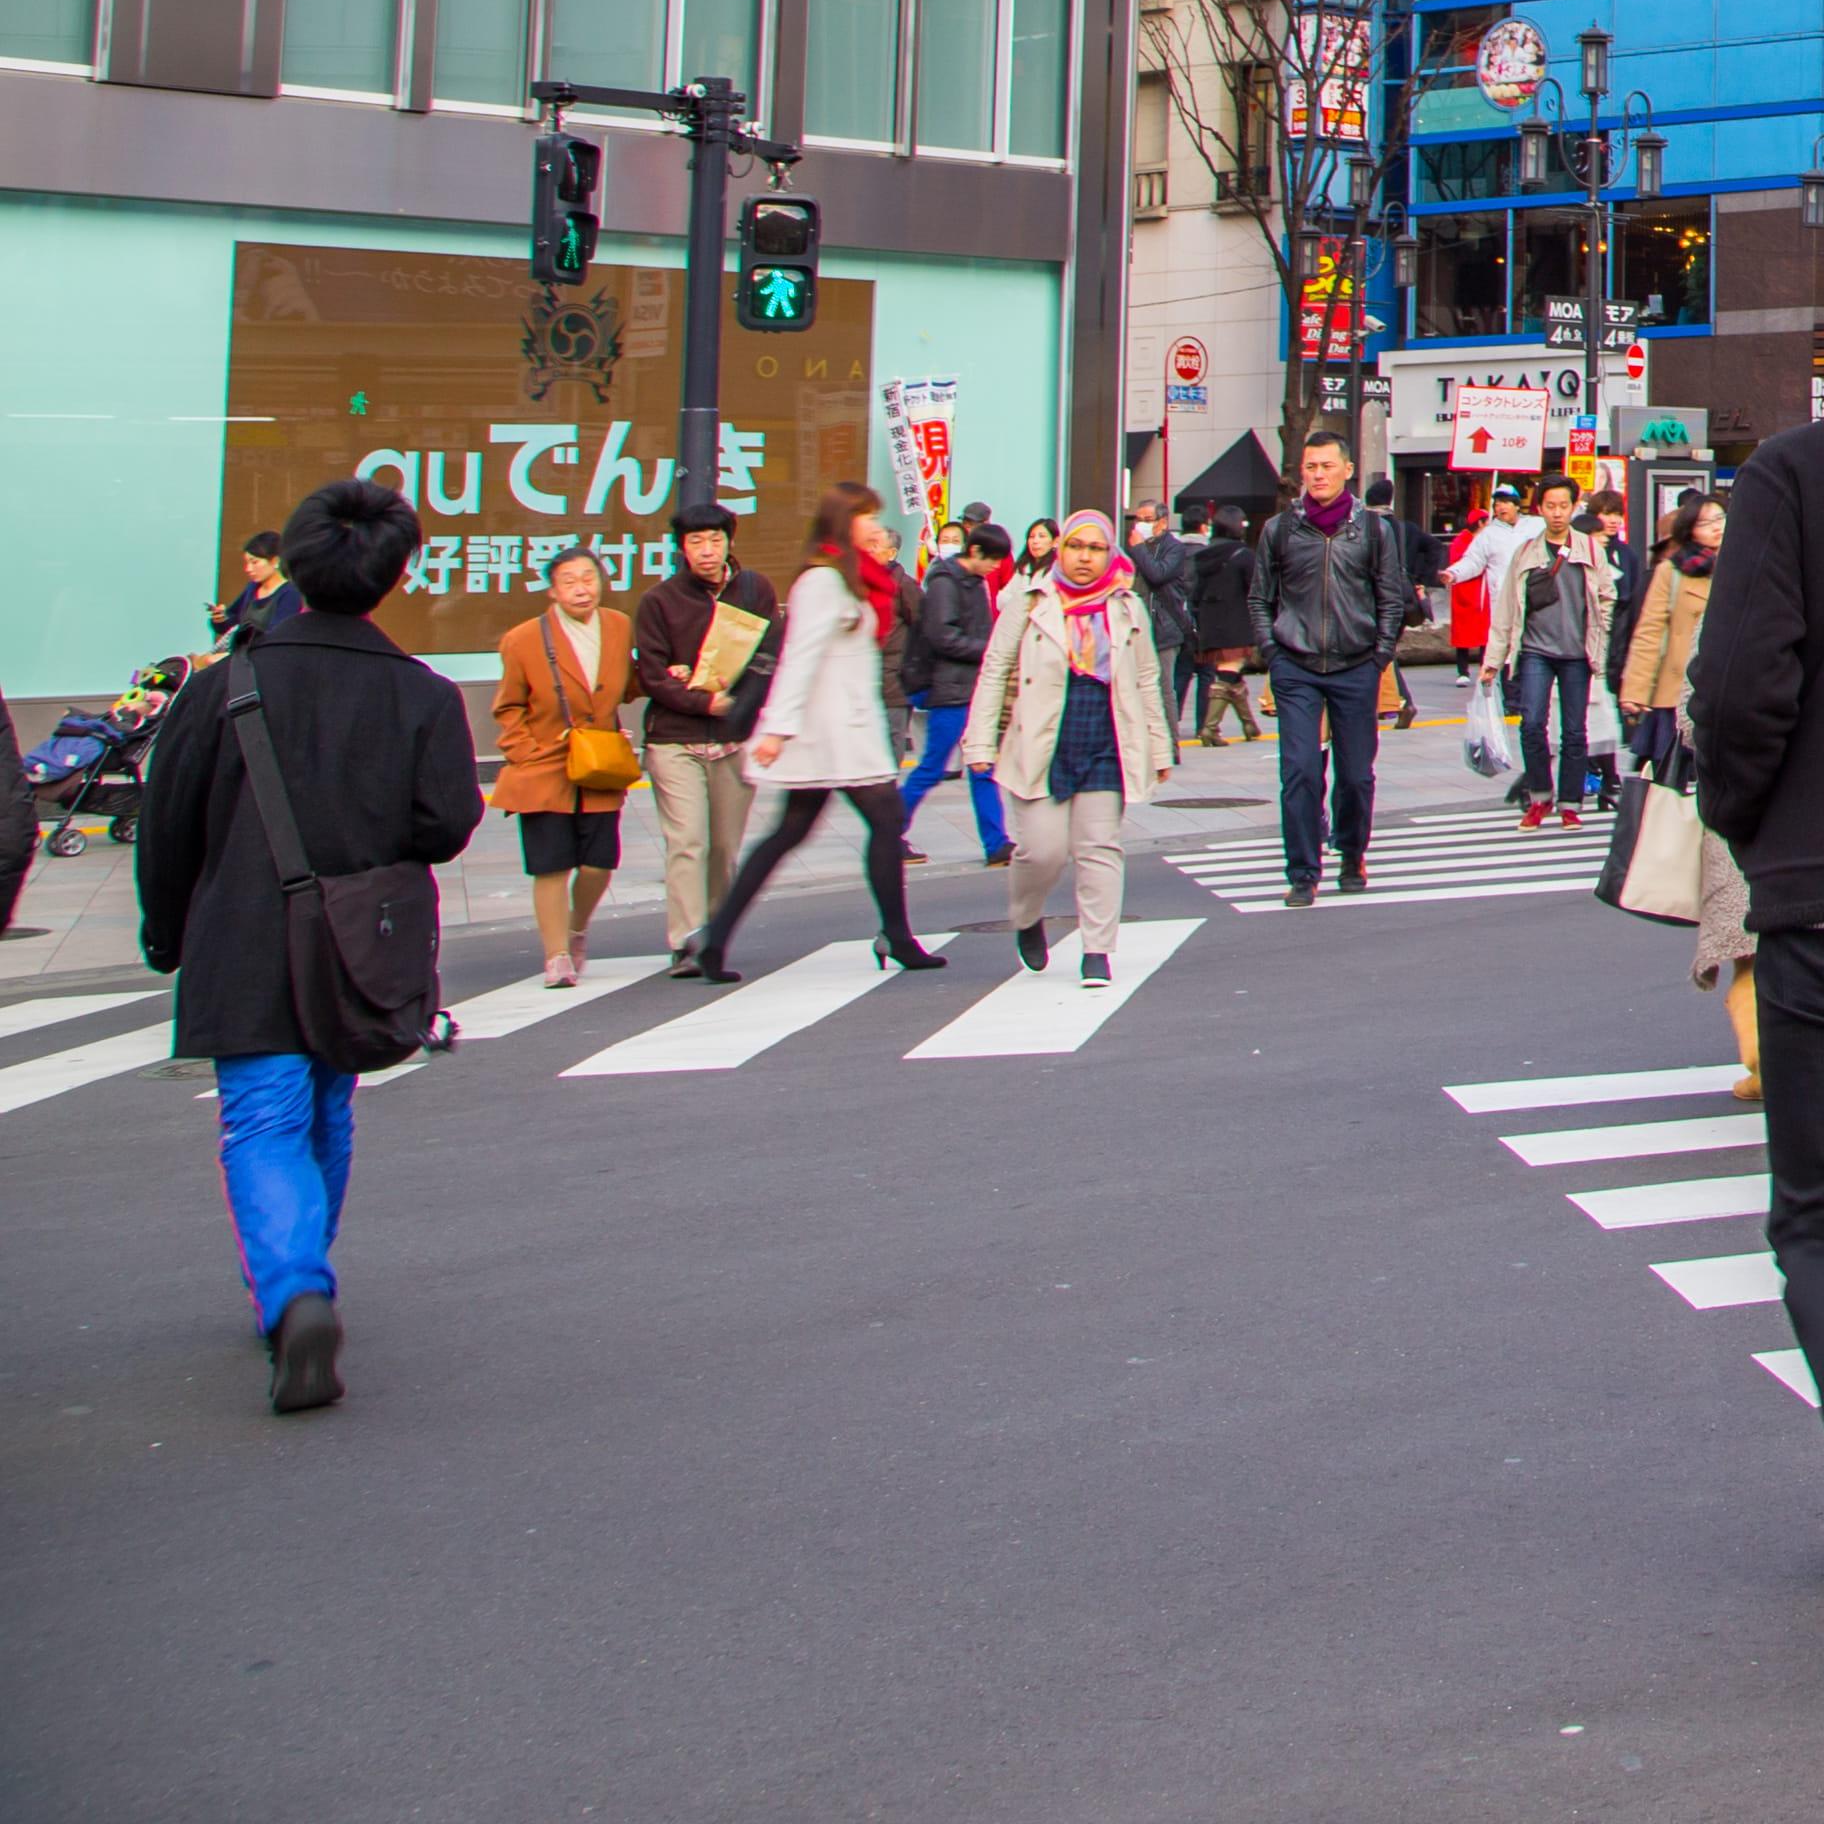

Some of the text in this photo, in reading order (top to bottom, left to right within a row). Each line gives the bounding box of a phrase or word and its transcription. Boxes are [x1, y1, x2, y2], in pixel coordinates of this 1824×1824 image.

[1549, 301, 1583, 320] MOA
[1605, 304, 1635, 322] モア
[1321, 377, 1346, 391] モア
[1363, 380, 1391, 394] MOA
[1460, 392, 1546, 410] コンタクトレンズ
